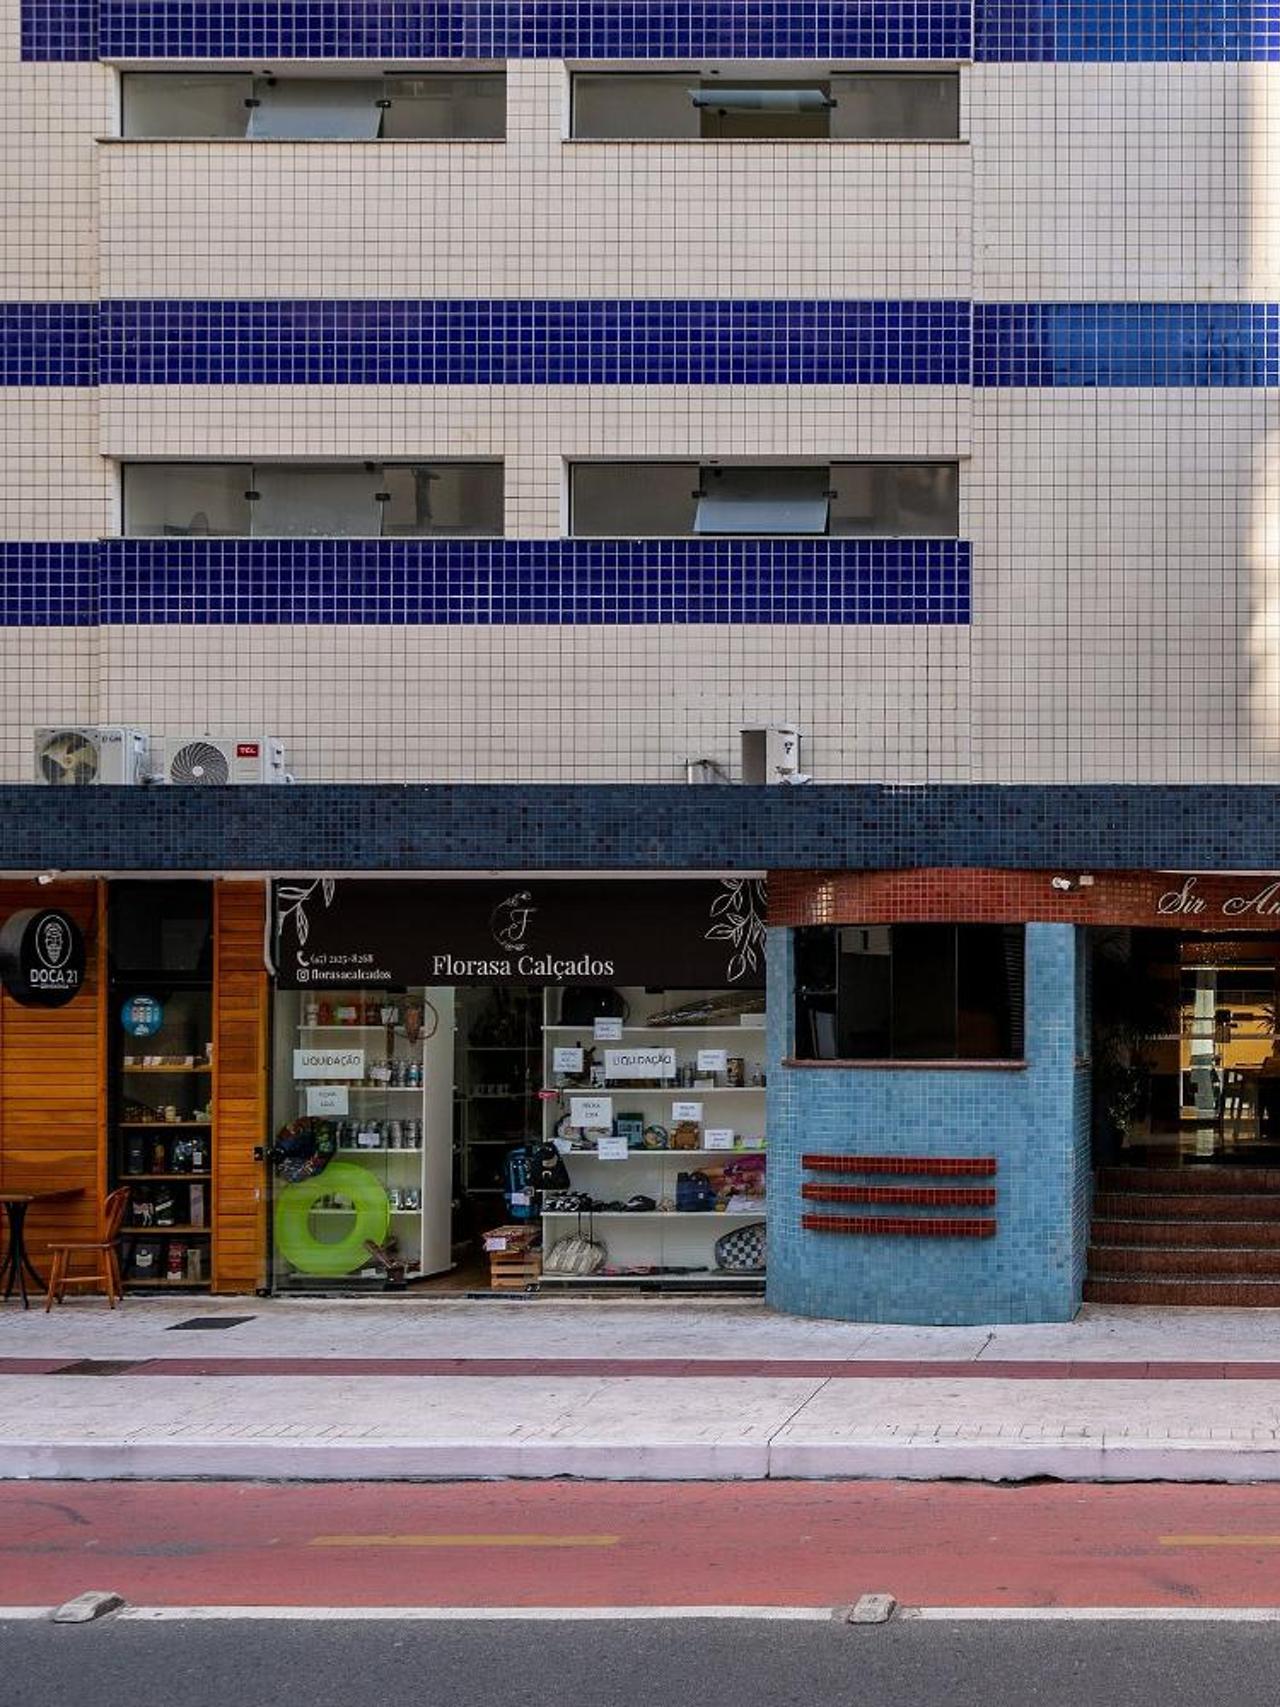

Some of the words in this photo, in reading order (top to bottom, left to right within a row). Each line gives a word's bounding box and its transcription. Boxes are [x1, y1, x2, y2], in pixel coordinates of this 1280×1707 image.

[239, 747, 256, 755] TCL
[1157, 876, 1208, 915] Sir
[432, 954, 512, 977] Florasa
[517, 954, 615, 981] Calçados
[30, 968, 65, 983] DOCA
[66, 970, 79, 984] 21
[302, 1052, 361, 1067] LIQUIDAÇÃO
[613, 1053, 672, 1067] LIQUIDAÇÃO
